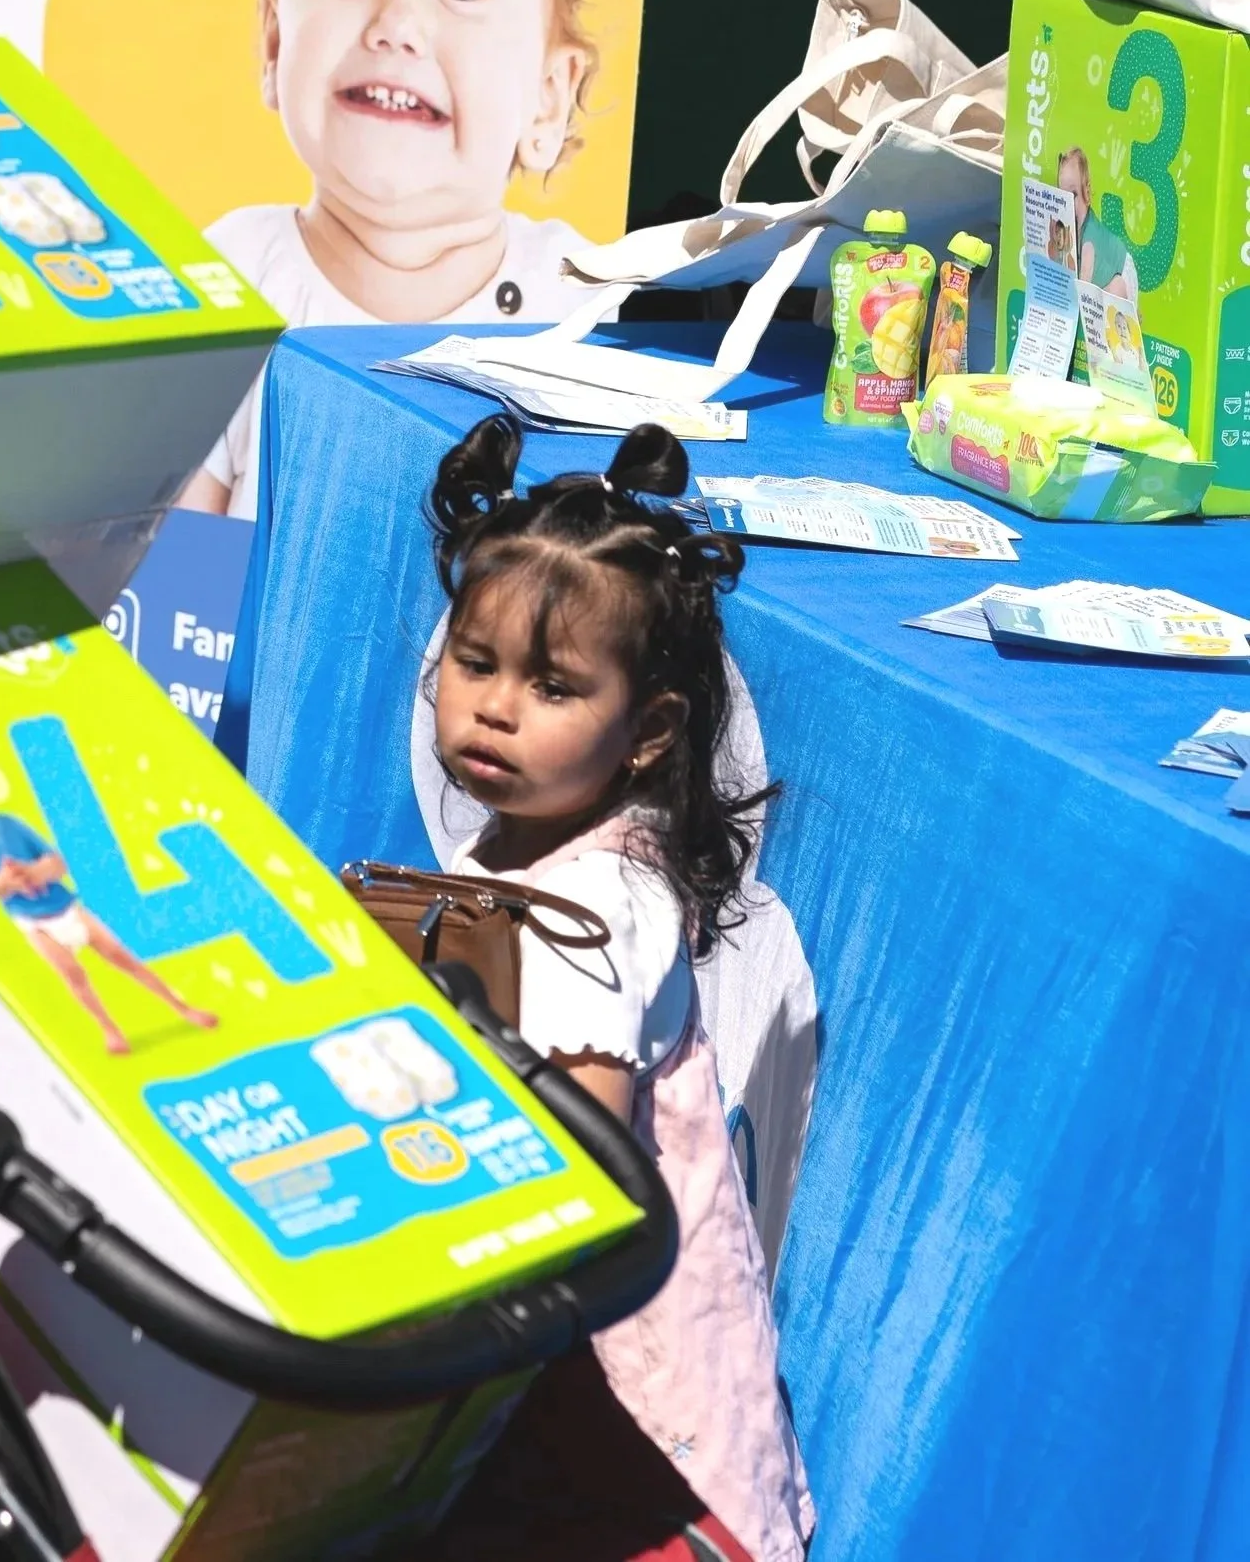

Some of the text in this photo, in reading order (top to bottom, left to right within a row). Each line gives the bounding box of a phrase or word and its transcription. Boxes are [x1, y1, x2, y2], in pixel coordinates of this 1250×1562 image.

[1100, 28, 1187, 294] 3
[920, 256, 931, 270] 2
[858, 378, 889, 389] APPLE,
[874, 387, 910, 396] SPINACH
[1154, 373, 1175, 409] 126
[957, 446, 1002, 474] FRAGRANCE FREE
[8, 714, 338, 985] 4
[173, 1086, 248, 1134] DAY
[201, 1104, 311, 1164] NIGHT
